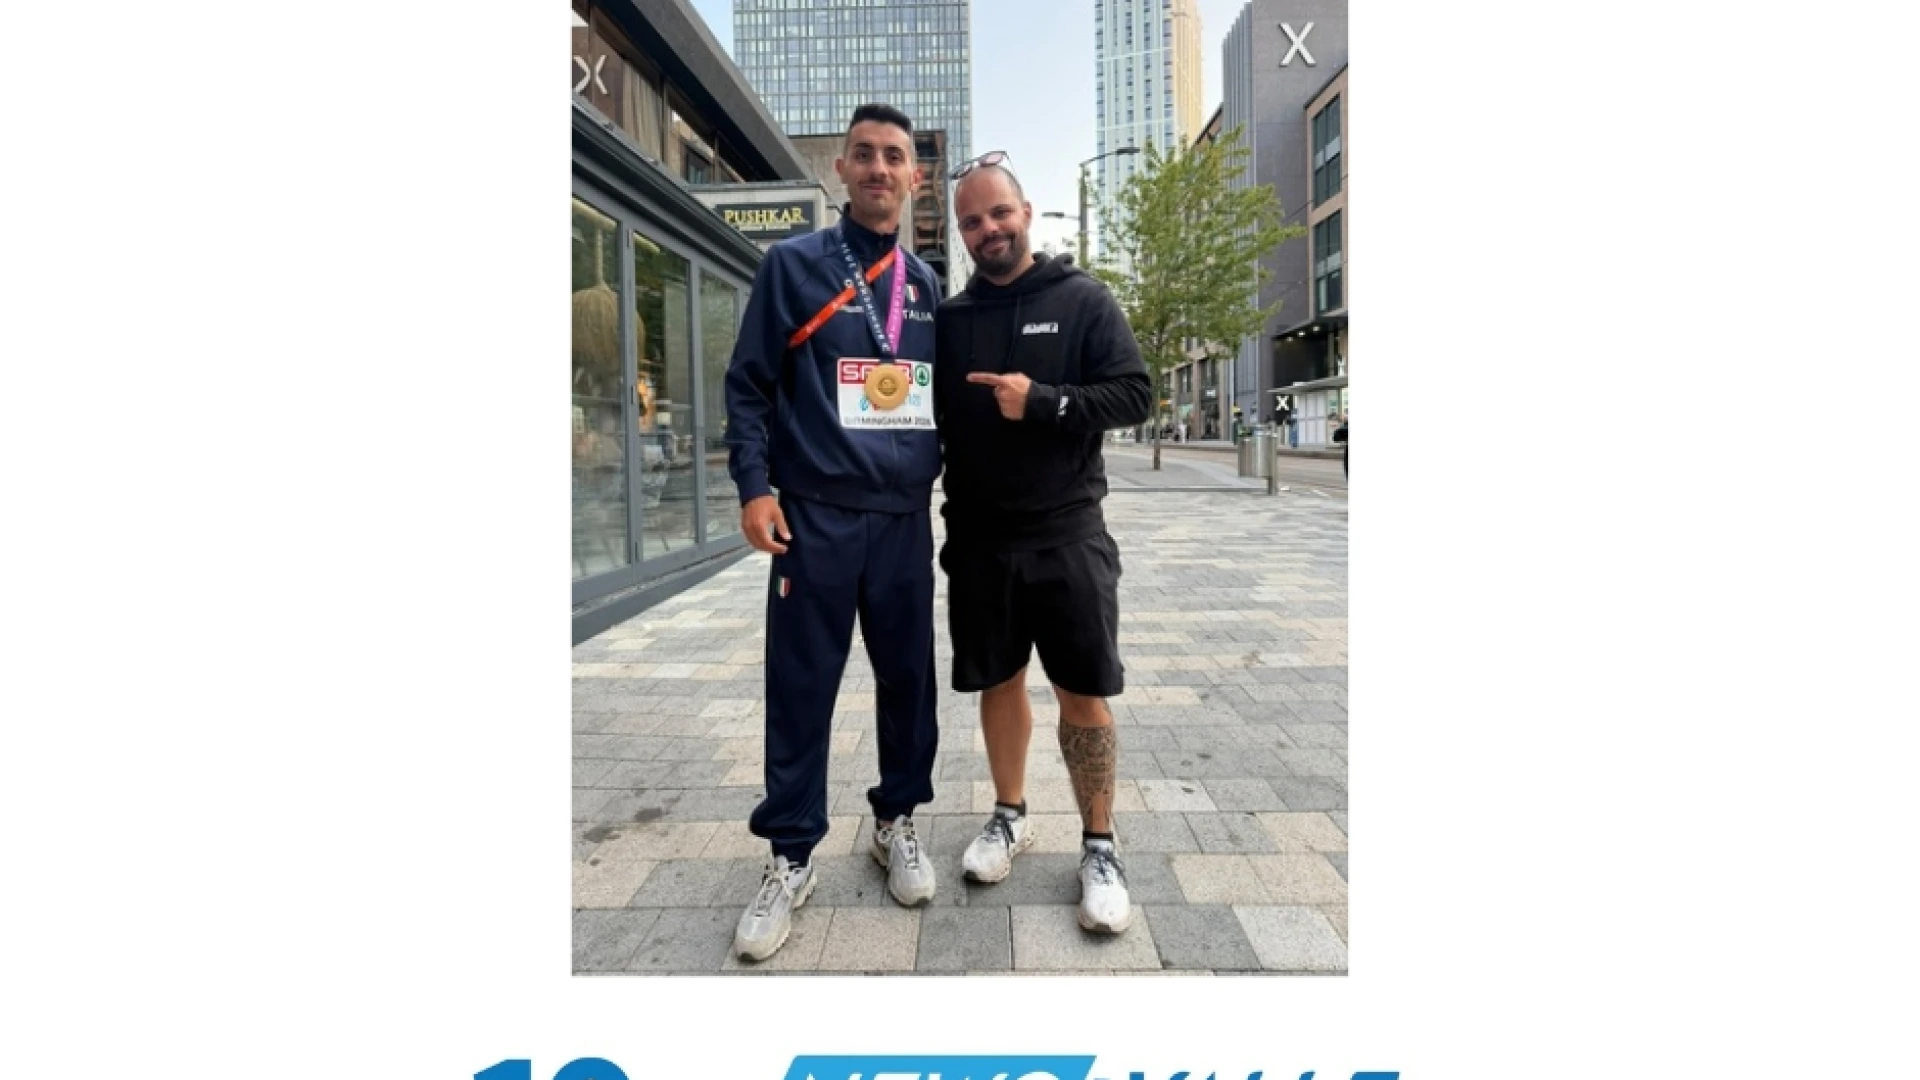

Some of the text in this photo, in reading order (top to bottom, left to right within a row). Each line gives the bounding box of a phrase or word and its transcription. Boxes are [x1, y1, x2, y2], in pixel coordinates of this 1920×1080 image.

[1280, 22, 1316, 67] X
[724, 207, 807, 225] PUSHKAR
[902, 310, 934, 322] TALIA
[1276, 396, 1290, 411] X
